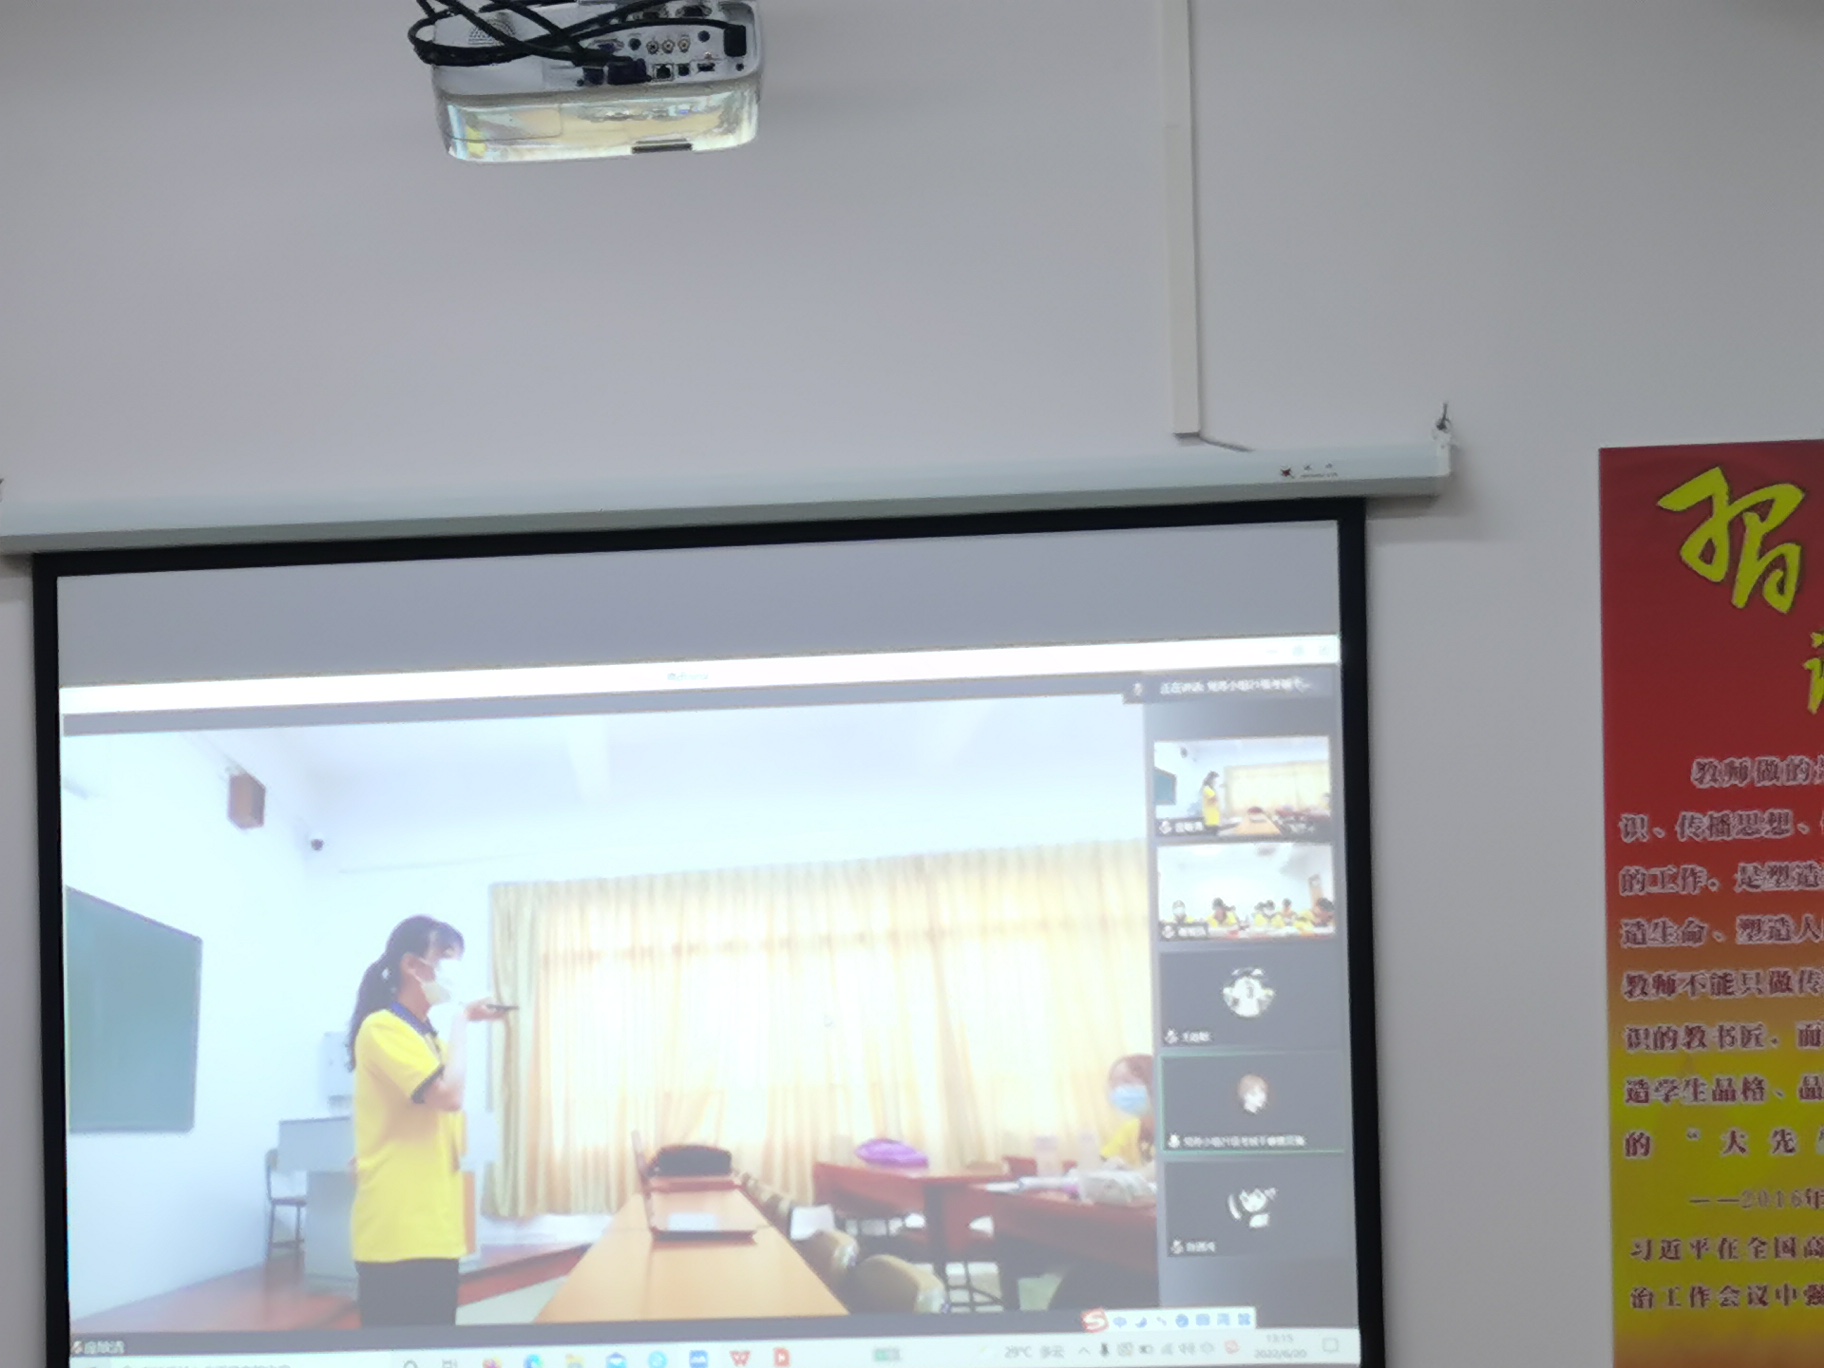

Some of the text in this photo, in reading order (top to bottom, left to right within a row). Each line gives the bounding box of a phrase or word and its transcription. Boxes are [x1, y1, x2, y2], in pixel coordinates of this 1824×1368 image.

[1691, 755, 1824, 789] 教师做的
[1622, 968, 1824, 1001] 教师不能只做传
[1624, 1126, 1824, 1160] 的“大先
[1630, 1234, 1824, 1262] 习近平在全国高
